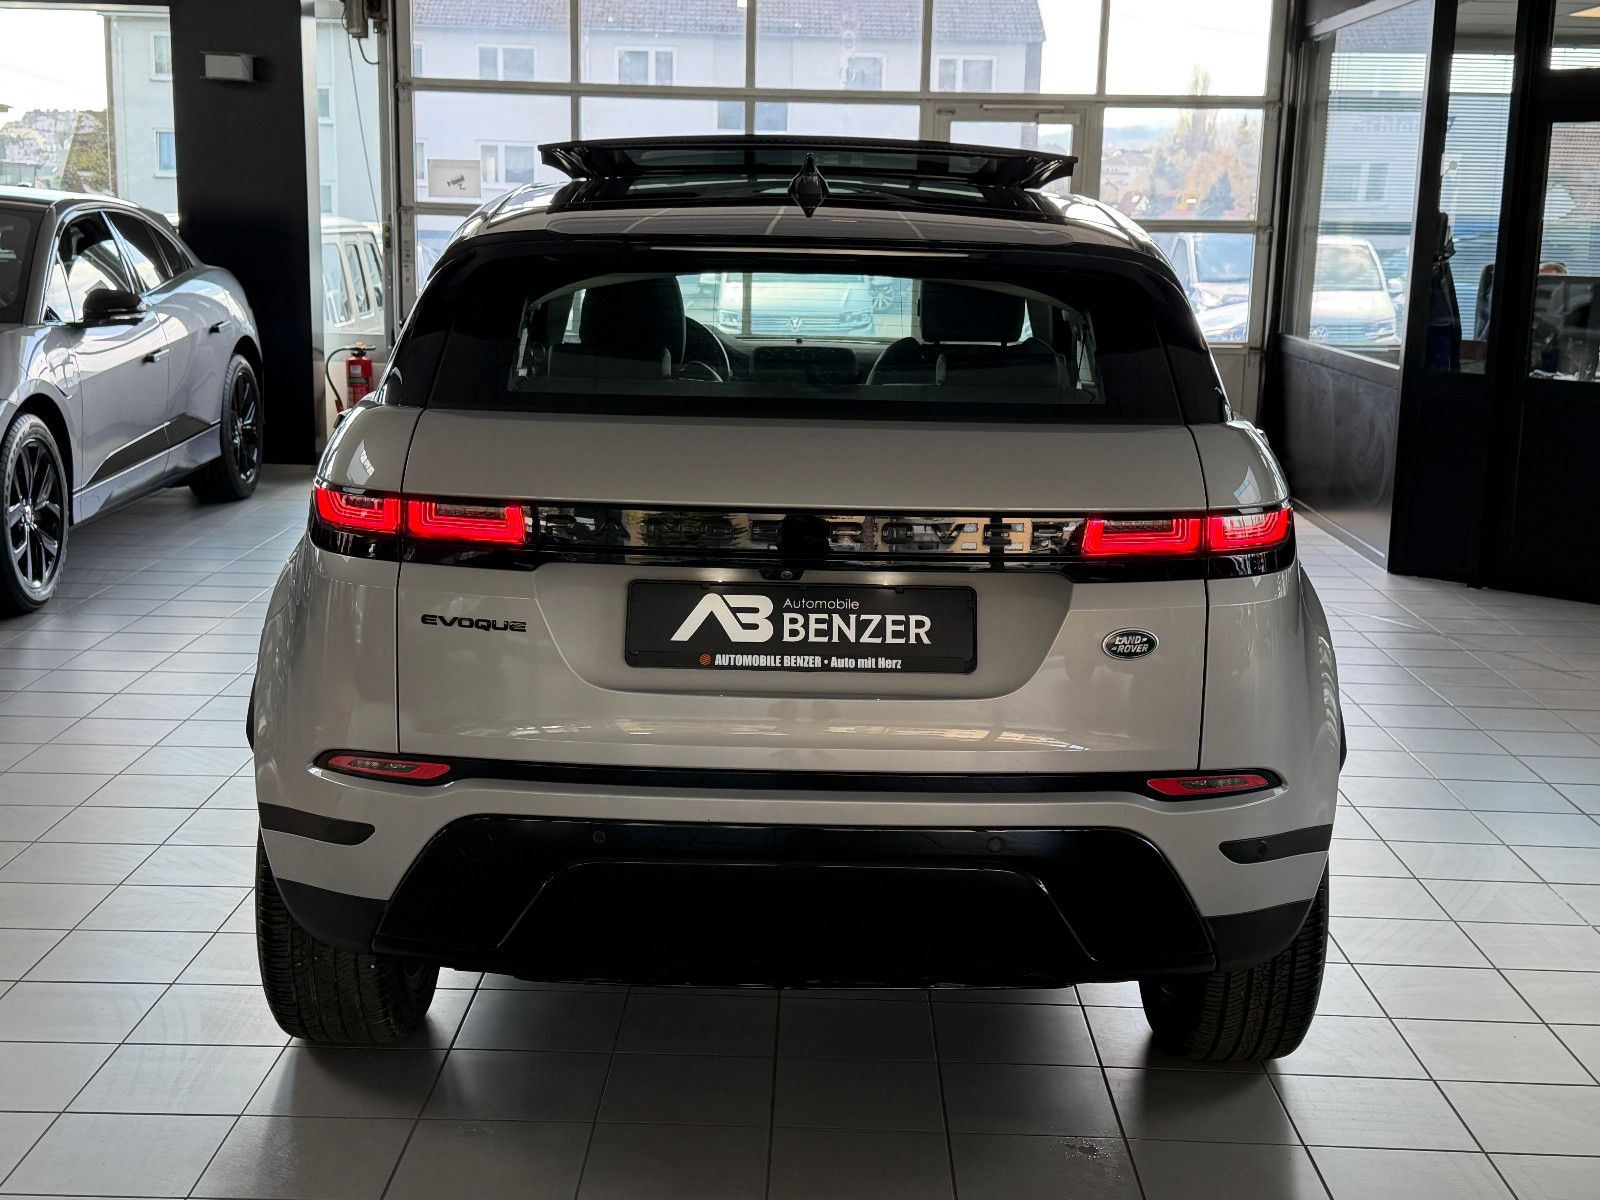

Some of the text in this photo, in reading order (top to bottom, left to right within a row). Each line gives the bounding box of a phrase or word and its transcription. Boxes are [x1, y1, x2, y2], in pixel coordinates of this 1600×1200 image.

[782, 598, 860, 610] Automobile
[420, 614, 527, 632] EVOQUE
[781, 612, 932, 644] BENZER
[1115, 636, 1141, 645] LAND
[1117, 644, 1149, 653] ROVER
[714, 654, 902, 669] AUTOMOBILE BENZER Auto mit Herz
